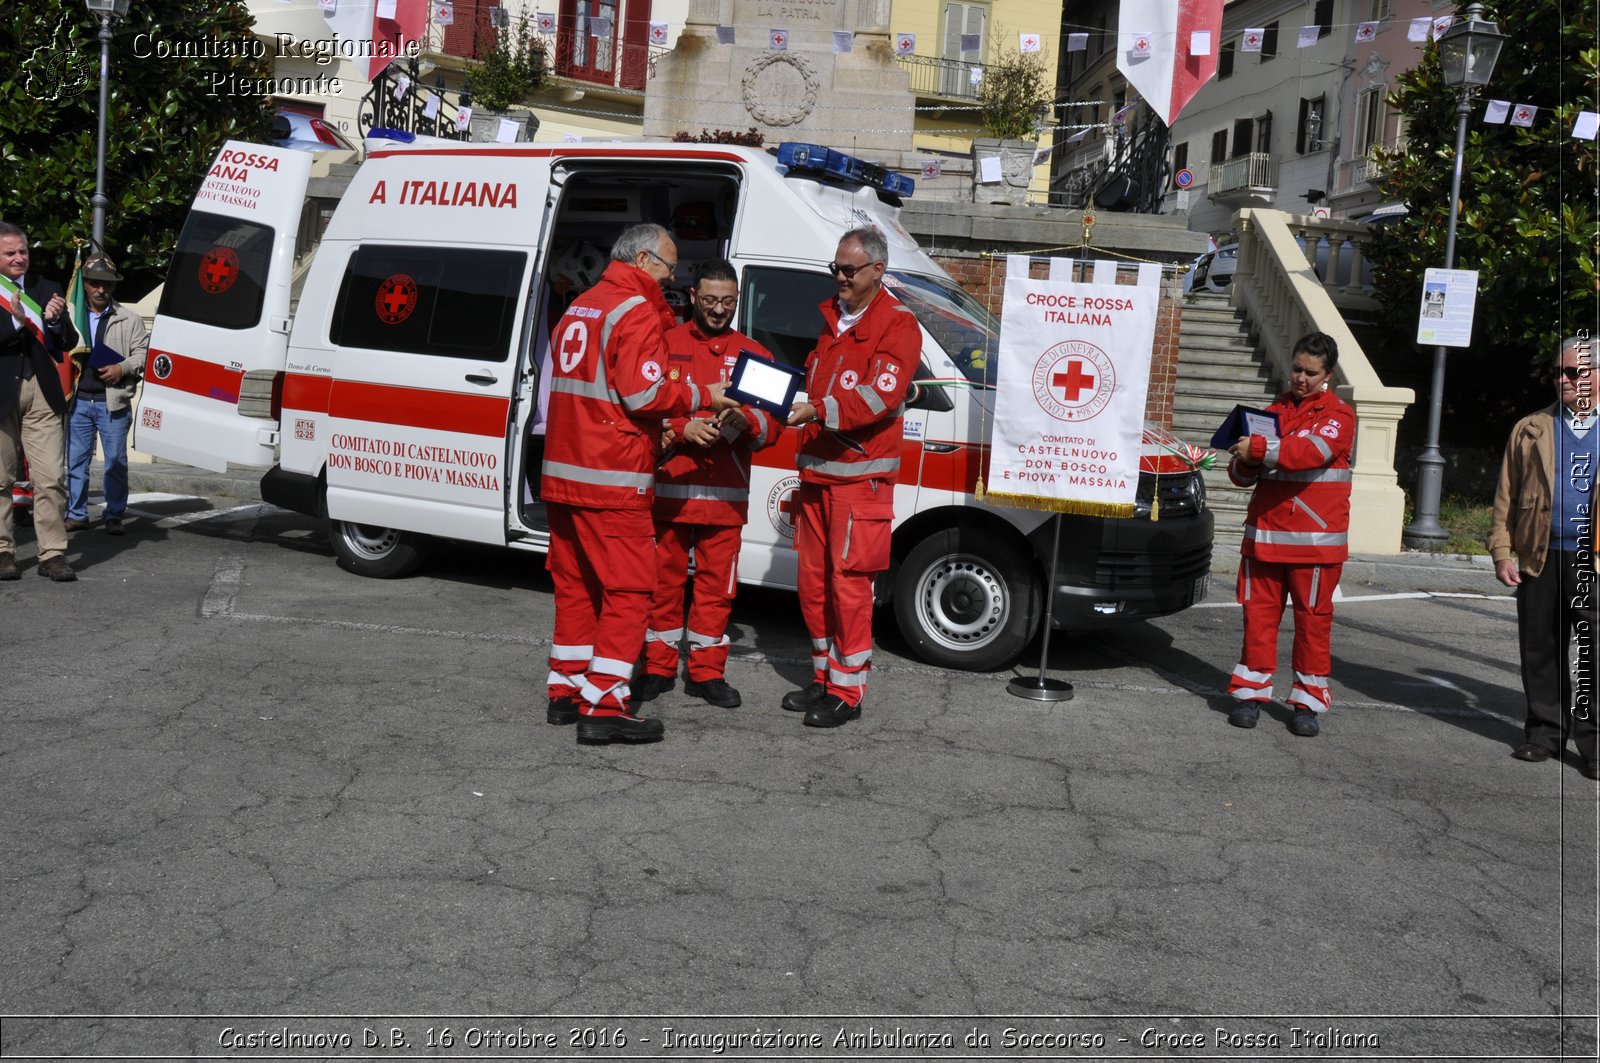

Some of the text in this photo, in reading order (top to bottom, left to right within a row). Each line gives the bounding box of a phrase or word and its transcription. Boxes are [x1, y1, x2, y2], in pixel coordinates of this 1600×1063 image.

[758, 7, 820, 20] LA PATRIA
[220, 149, 279, 172] ROSSA
[208, 164, 248, 182] ANA
[219, 193, 257, 209] MASSAIA
[368, 180, 517, 208] A ITALIANA
[1026, 293, 1134, 311] CROCE ROSSA
[1045, 311, 1112, 326] ITALIANA
[1048, 350, 1059, 360] DI
[1060, 343, 1100, 362] GINEVRA
[1098, 361, 1110, 372] 22
[1035, 359, 1065, 417] CONVENZIONE
[1093, 374, 1112, 408] AGOSTO
[144, 409, 161, 419] AT 14
[142, 418, 161, 429] 12-25
[296, 421, 314, 430] AT 14
[295, 430, 314, 440] 12-25
[1042, 435, 1096, 446] COMITATO DI
[331, 433, 497, 470] COMITATO DI CASTELNUOVO
[1018, 445, 1117, 461] CASTELNUOVO
[329, 453, 500, 491] DON BOSCO E PIOVA' MASSAIA
[1025, 459, 1107, 474] DON BOSCO
[1004, 471, 1126, 489] E PIOVA' MASSAIA
[769, 485, 782, 509] CROCE
